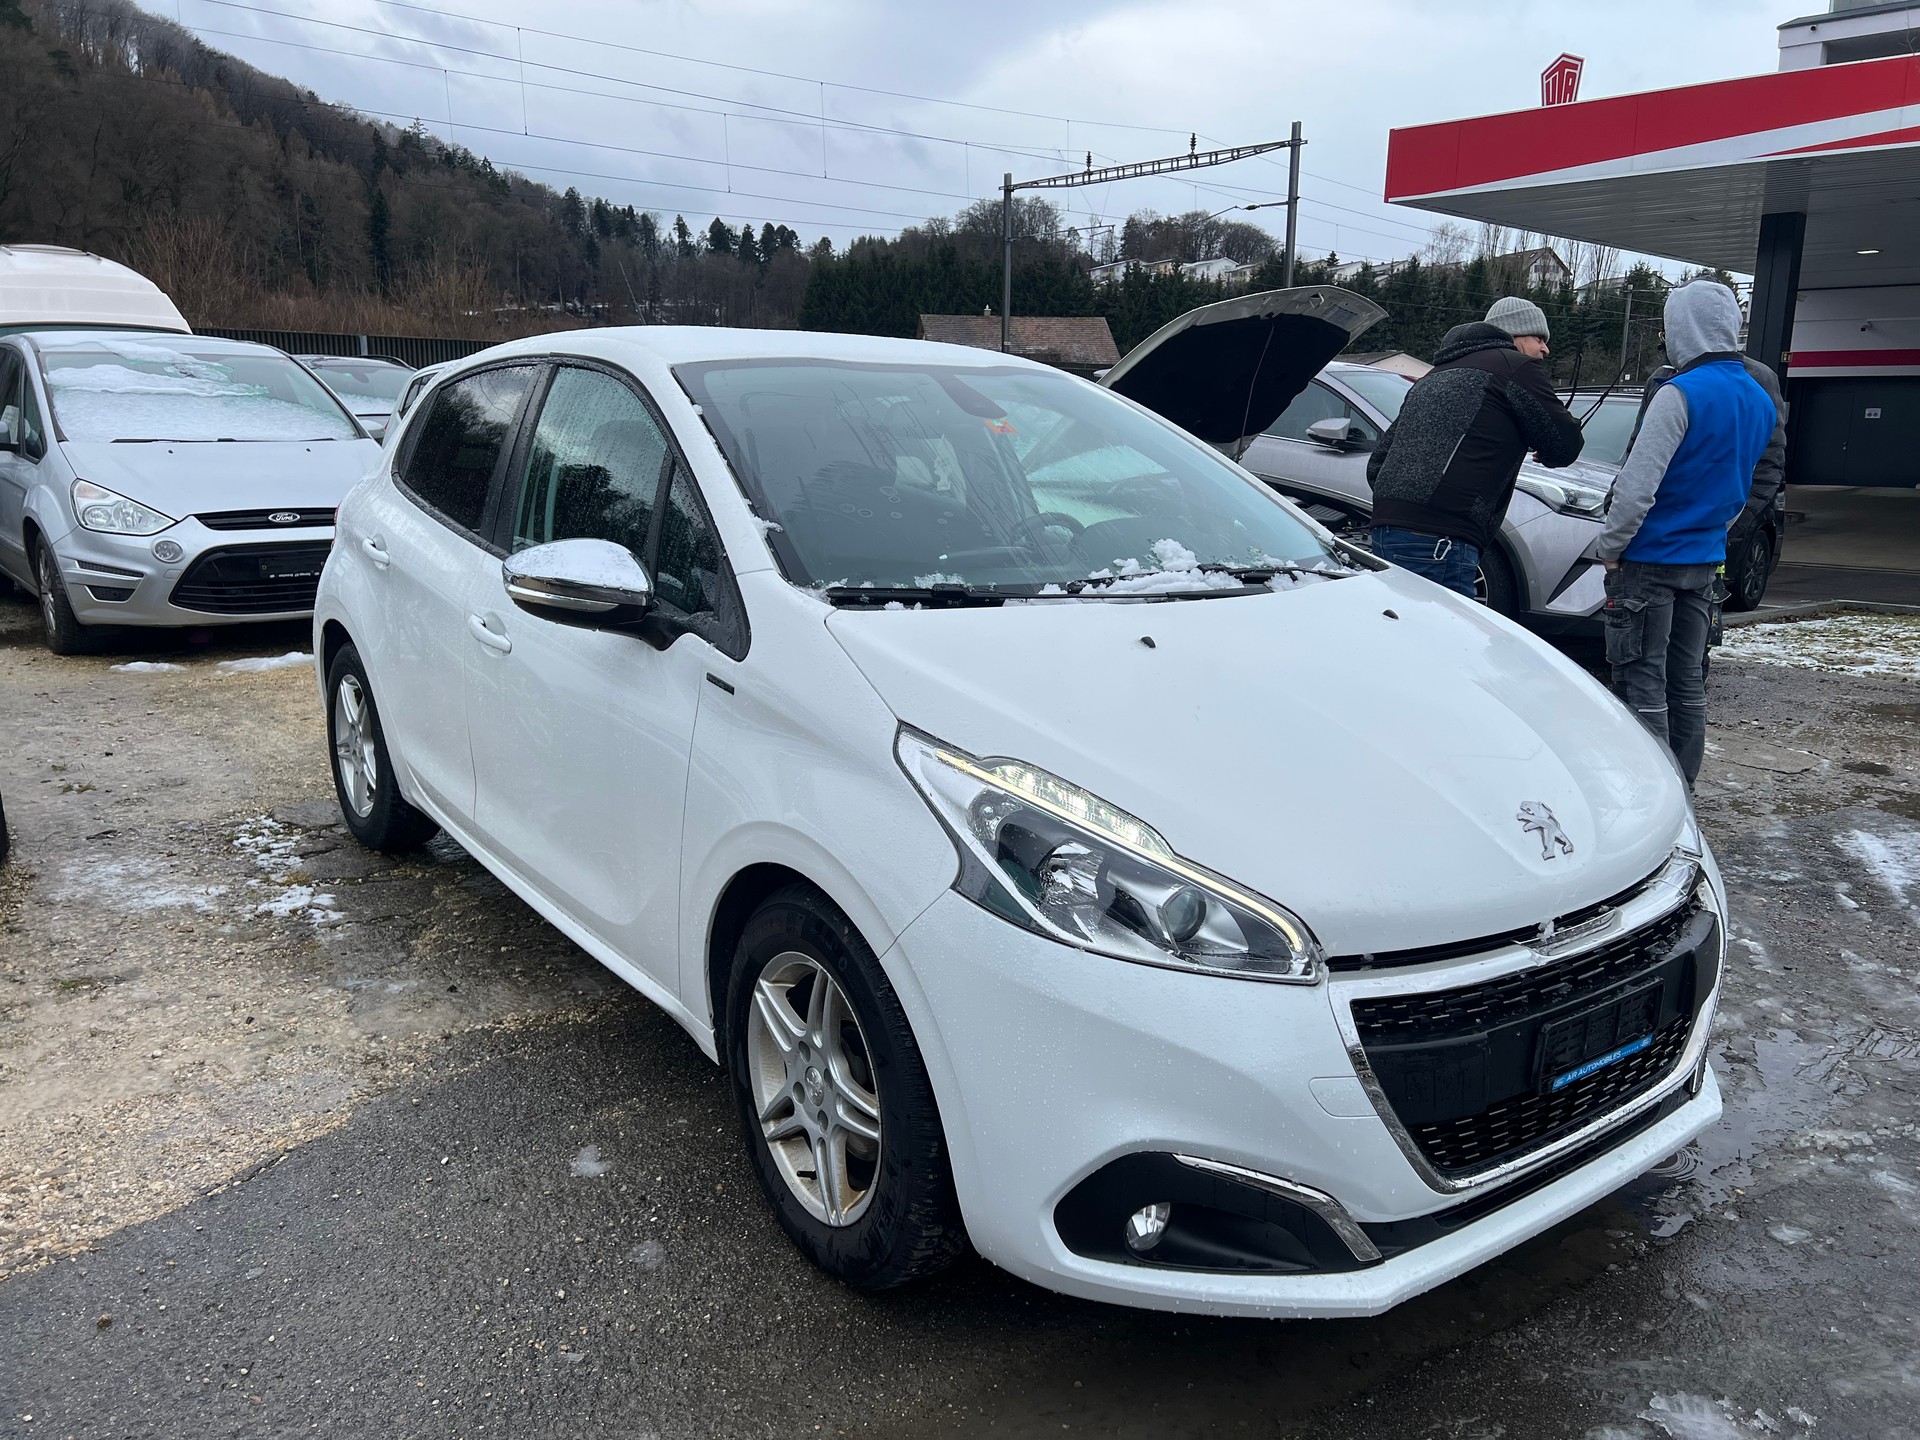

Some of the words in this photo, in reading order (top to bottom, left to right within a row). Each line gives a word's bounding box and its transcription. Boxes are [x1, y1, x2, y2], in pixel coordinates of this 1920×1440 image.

[273, 512, 296, 522] Ford
[1566, 1070, 1578, 1081] AR
[1577, 1050, 1622, 1076] AUTOMOBILES
